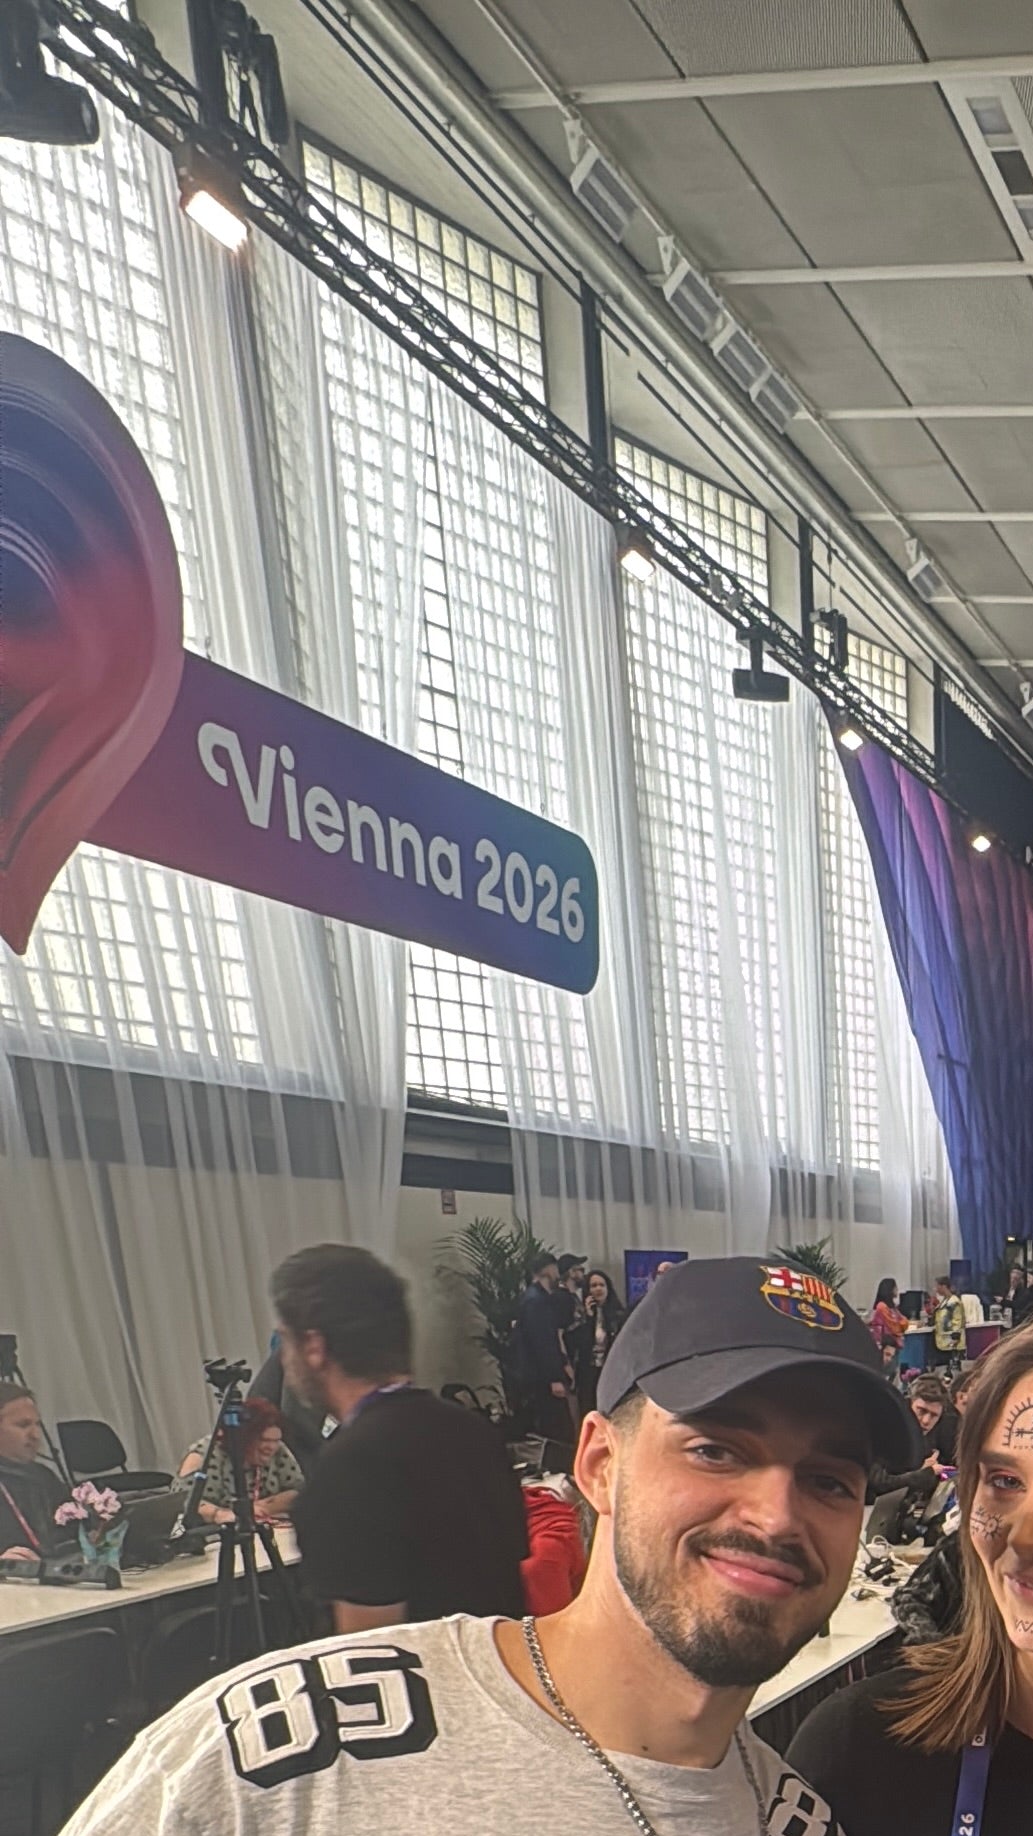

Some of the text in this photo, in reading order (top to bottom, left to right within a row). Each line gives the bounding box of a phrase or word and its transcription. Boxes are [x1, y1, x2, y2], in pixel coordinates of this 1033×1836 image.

[197, 721, 585, 943] Vienna 2026
[217, 1645, 438, 1789] 85
